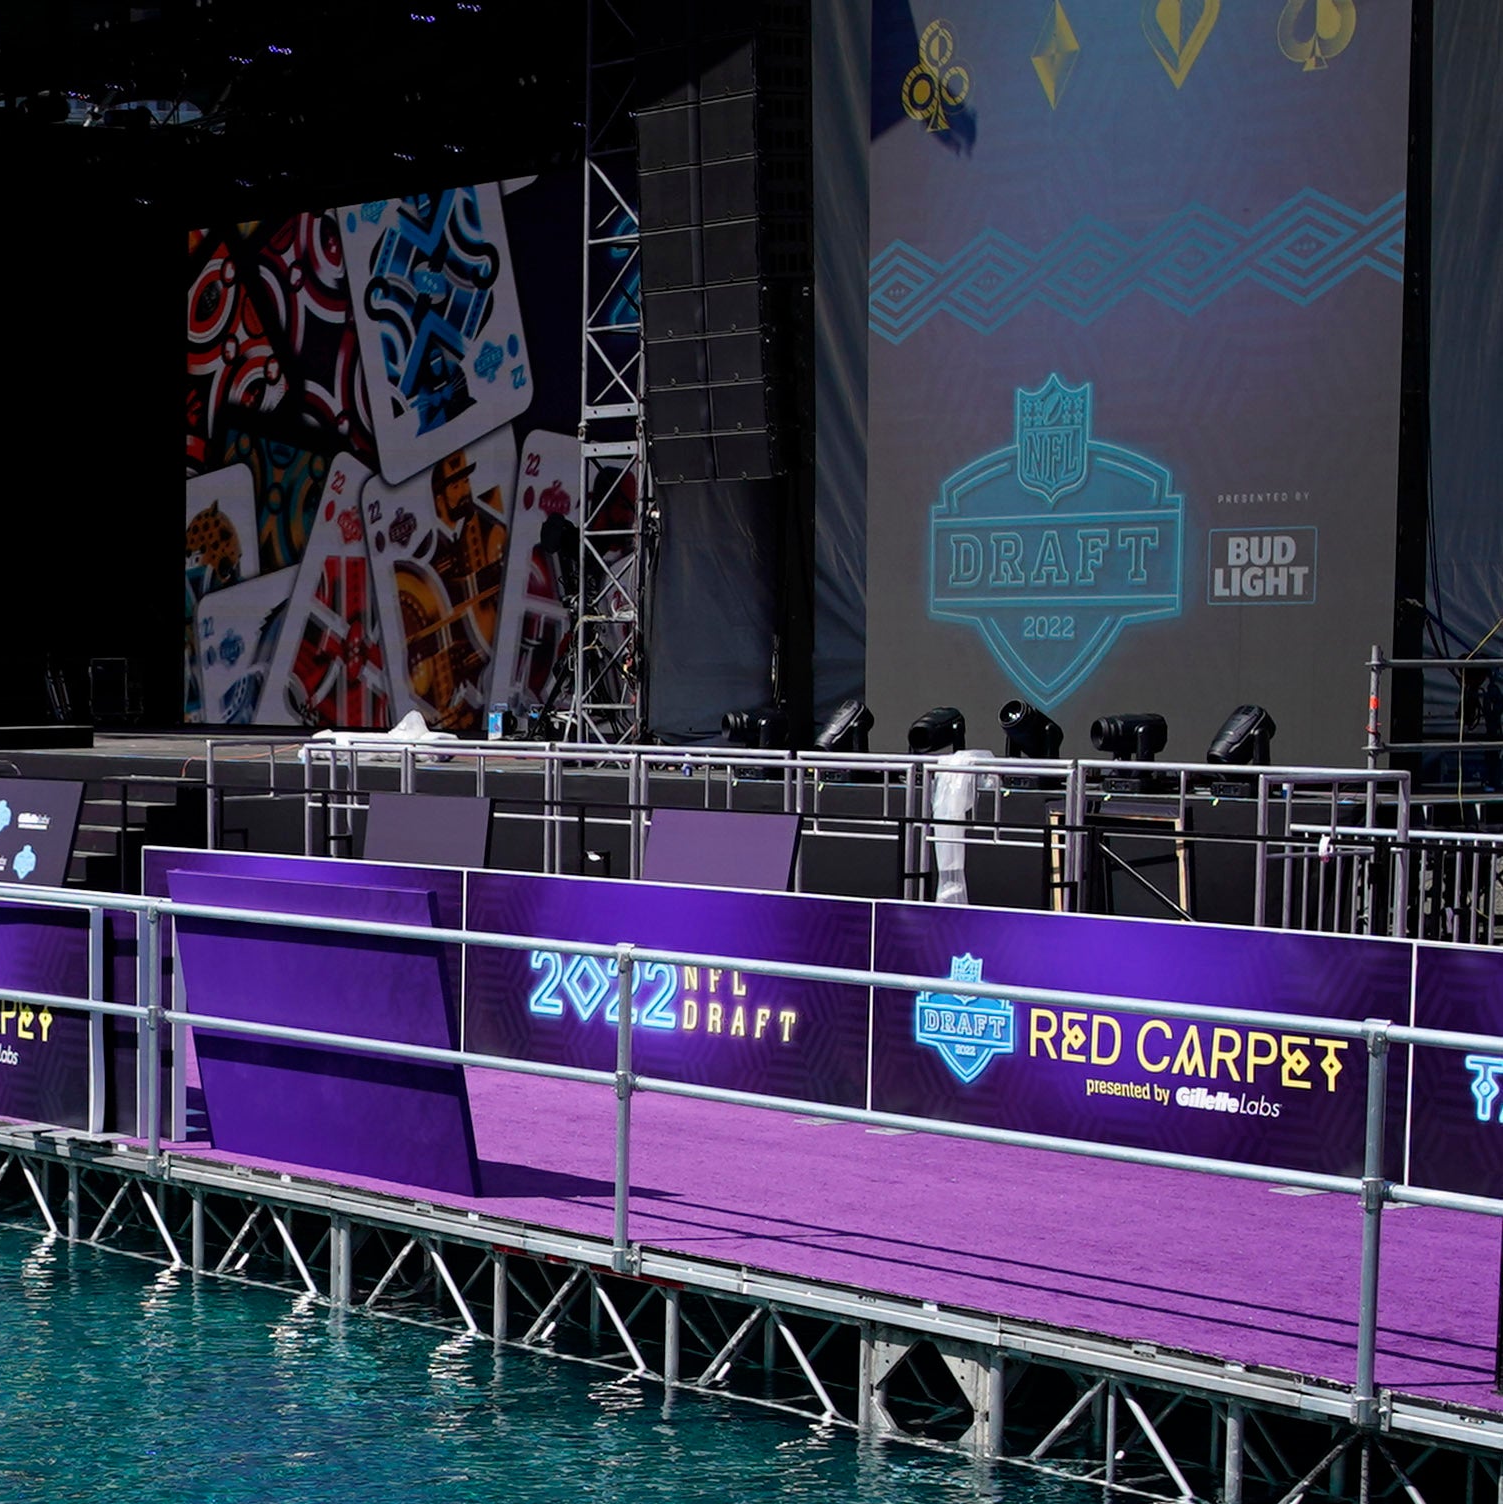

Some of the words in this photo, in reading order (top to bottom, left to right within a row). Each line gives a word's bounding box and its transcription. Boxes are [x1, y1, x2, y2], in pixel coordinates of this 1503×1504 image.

[524, 452, 541, 478] 22
[1024, 430, 1082, 480] NFL
[330, 469, 346, 495] 22
[1217, 492, 1290, 505] PRESENTED
[1294, 491, 1311, 502] BY
[368, 500, 383, 525] 22
[949, 526, 1159, 588] DRAFT
[1226, 534, 1297, 567] BUD
[1213, 566, 1309, 598] LIGHT
[1022, 615, 1076, 640] 2022
[683, 965, 747, 996] NFL
[682, 999, 796, 1043] DRAFT
[923, 1008, 1006, 1040] DRAFT
[954, 1043, 977, 1057] 2022
[1028, 1007, 1123, 1067] RED
[1136, 1019, 1349, 1093] CARPET
[1086, 1078, 1151, 1101] presented
[1153, 1083, 1171, 1106] by
[1175, 1085, 1280, 1119] GilletteLabs
[1464, 1053, 1503, 1124] T
